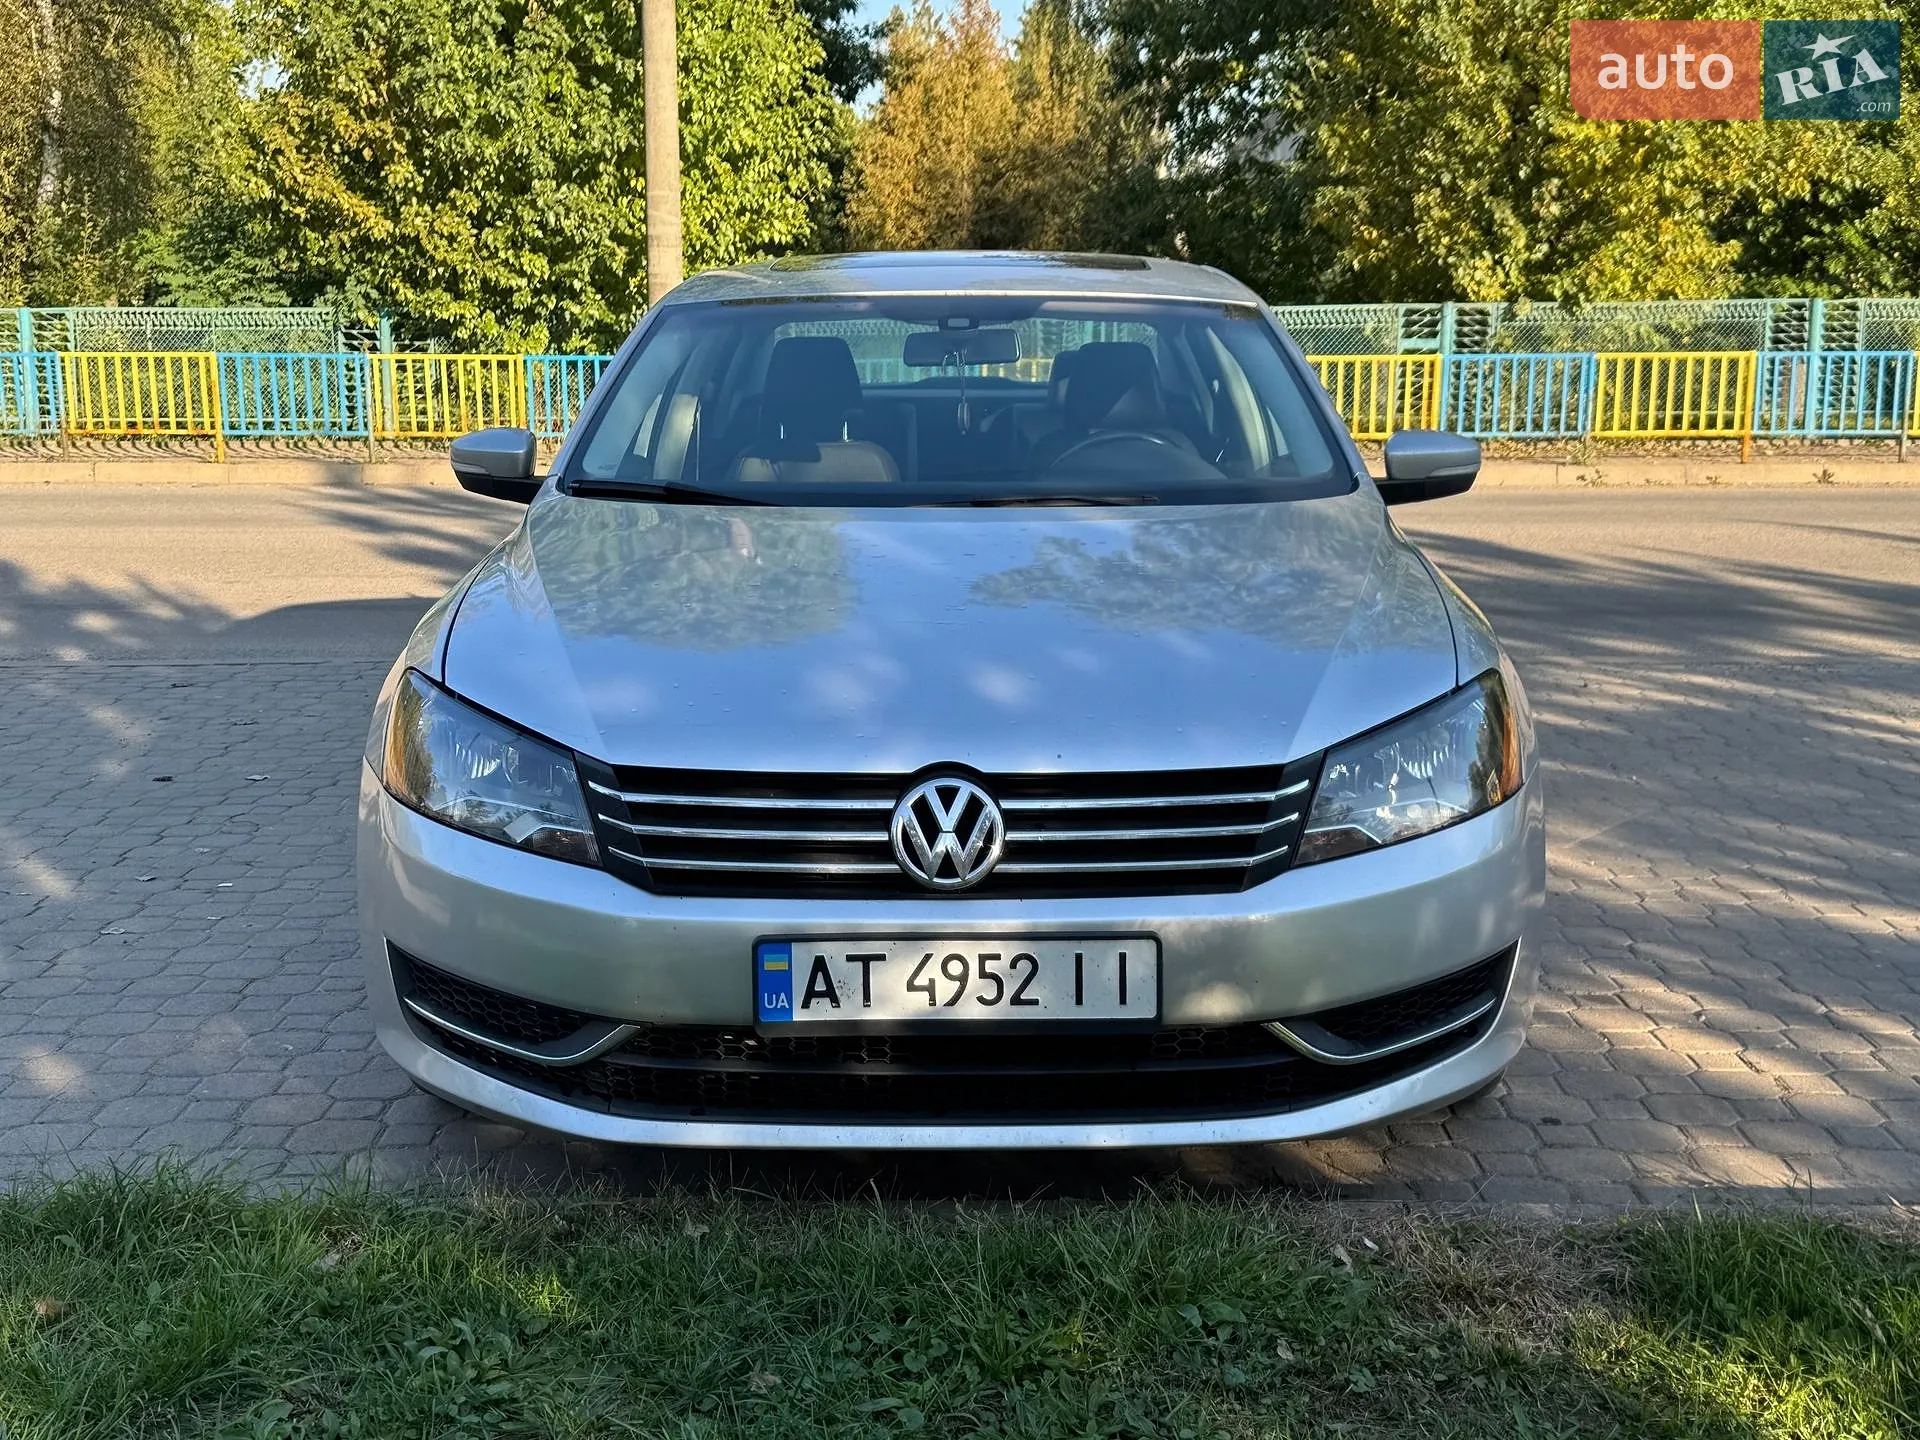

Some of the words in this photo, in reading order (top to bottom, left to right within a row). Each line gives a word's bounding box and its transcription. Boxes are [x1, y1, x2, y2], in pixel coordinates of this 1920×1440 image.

[895, 780, 1000, 886] VW
[764, 992, 789, 1009] UA
[800, 953, 887, 1009] AT
[906, 952, 1040, 1007] 4952
[1074, 951, 1128, 1006] II
